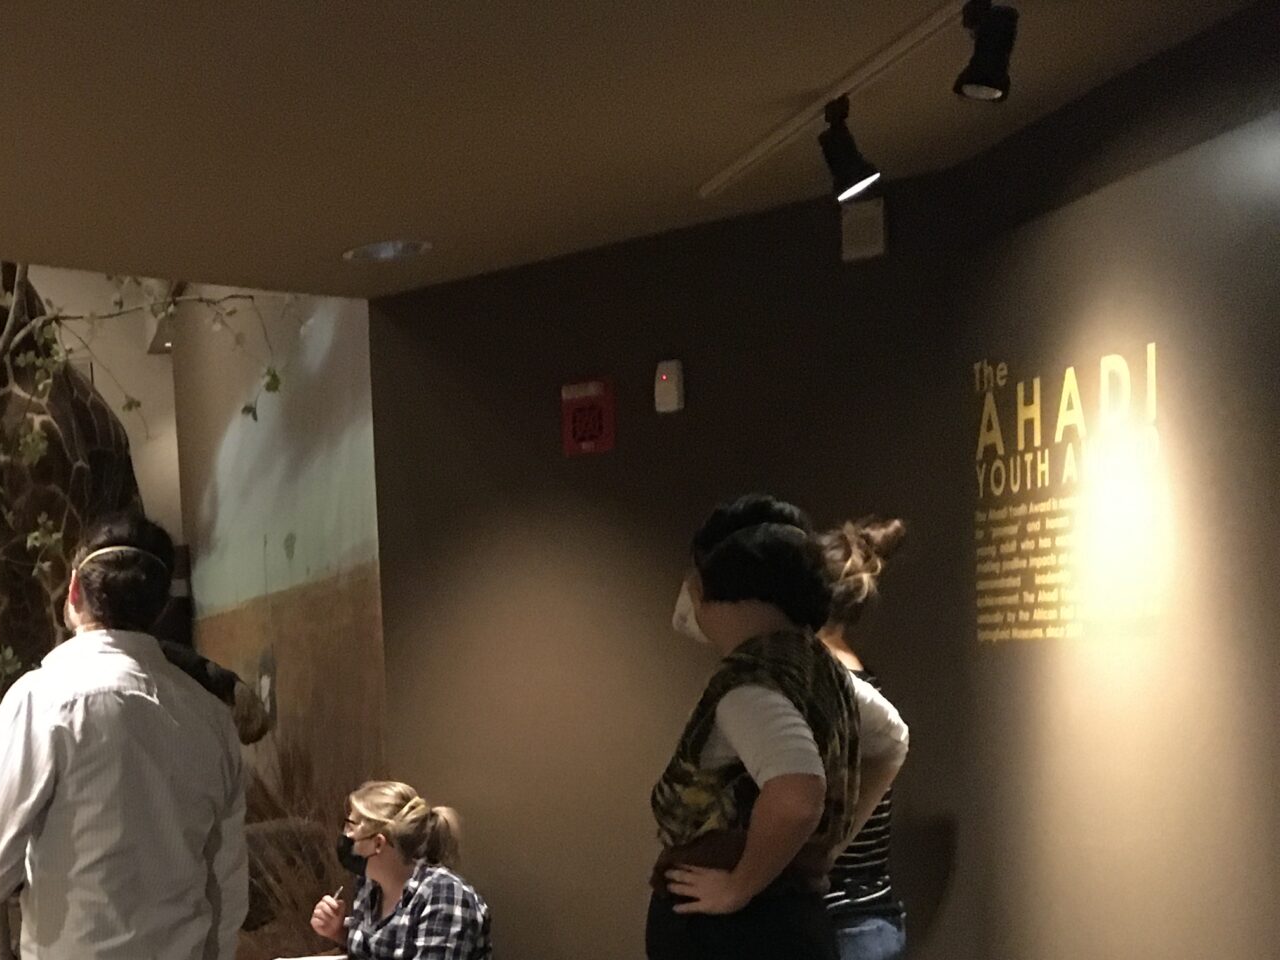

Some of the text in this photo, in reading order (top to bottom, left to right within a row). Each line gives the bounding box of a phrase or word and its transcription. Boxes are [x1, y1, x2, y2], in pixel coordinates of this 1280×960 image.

[974, 359, 1008, 391] The
[975, 342, 1157, 461] AHADI
[975, 448, 1050, 499] YOUTH
